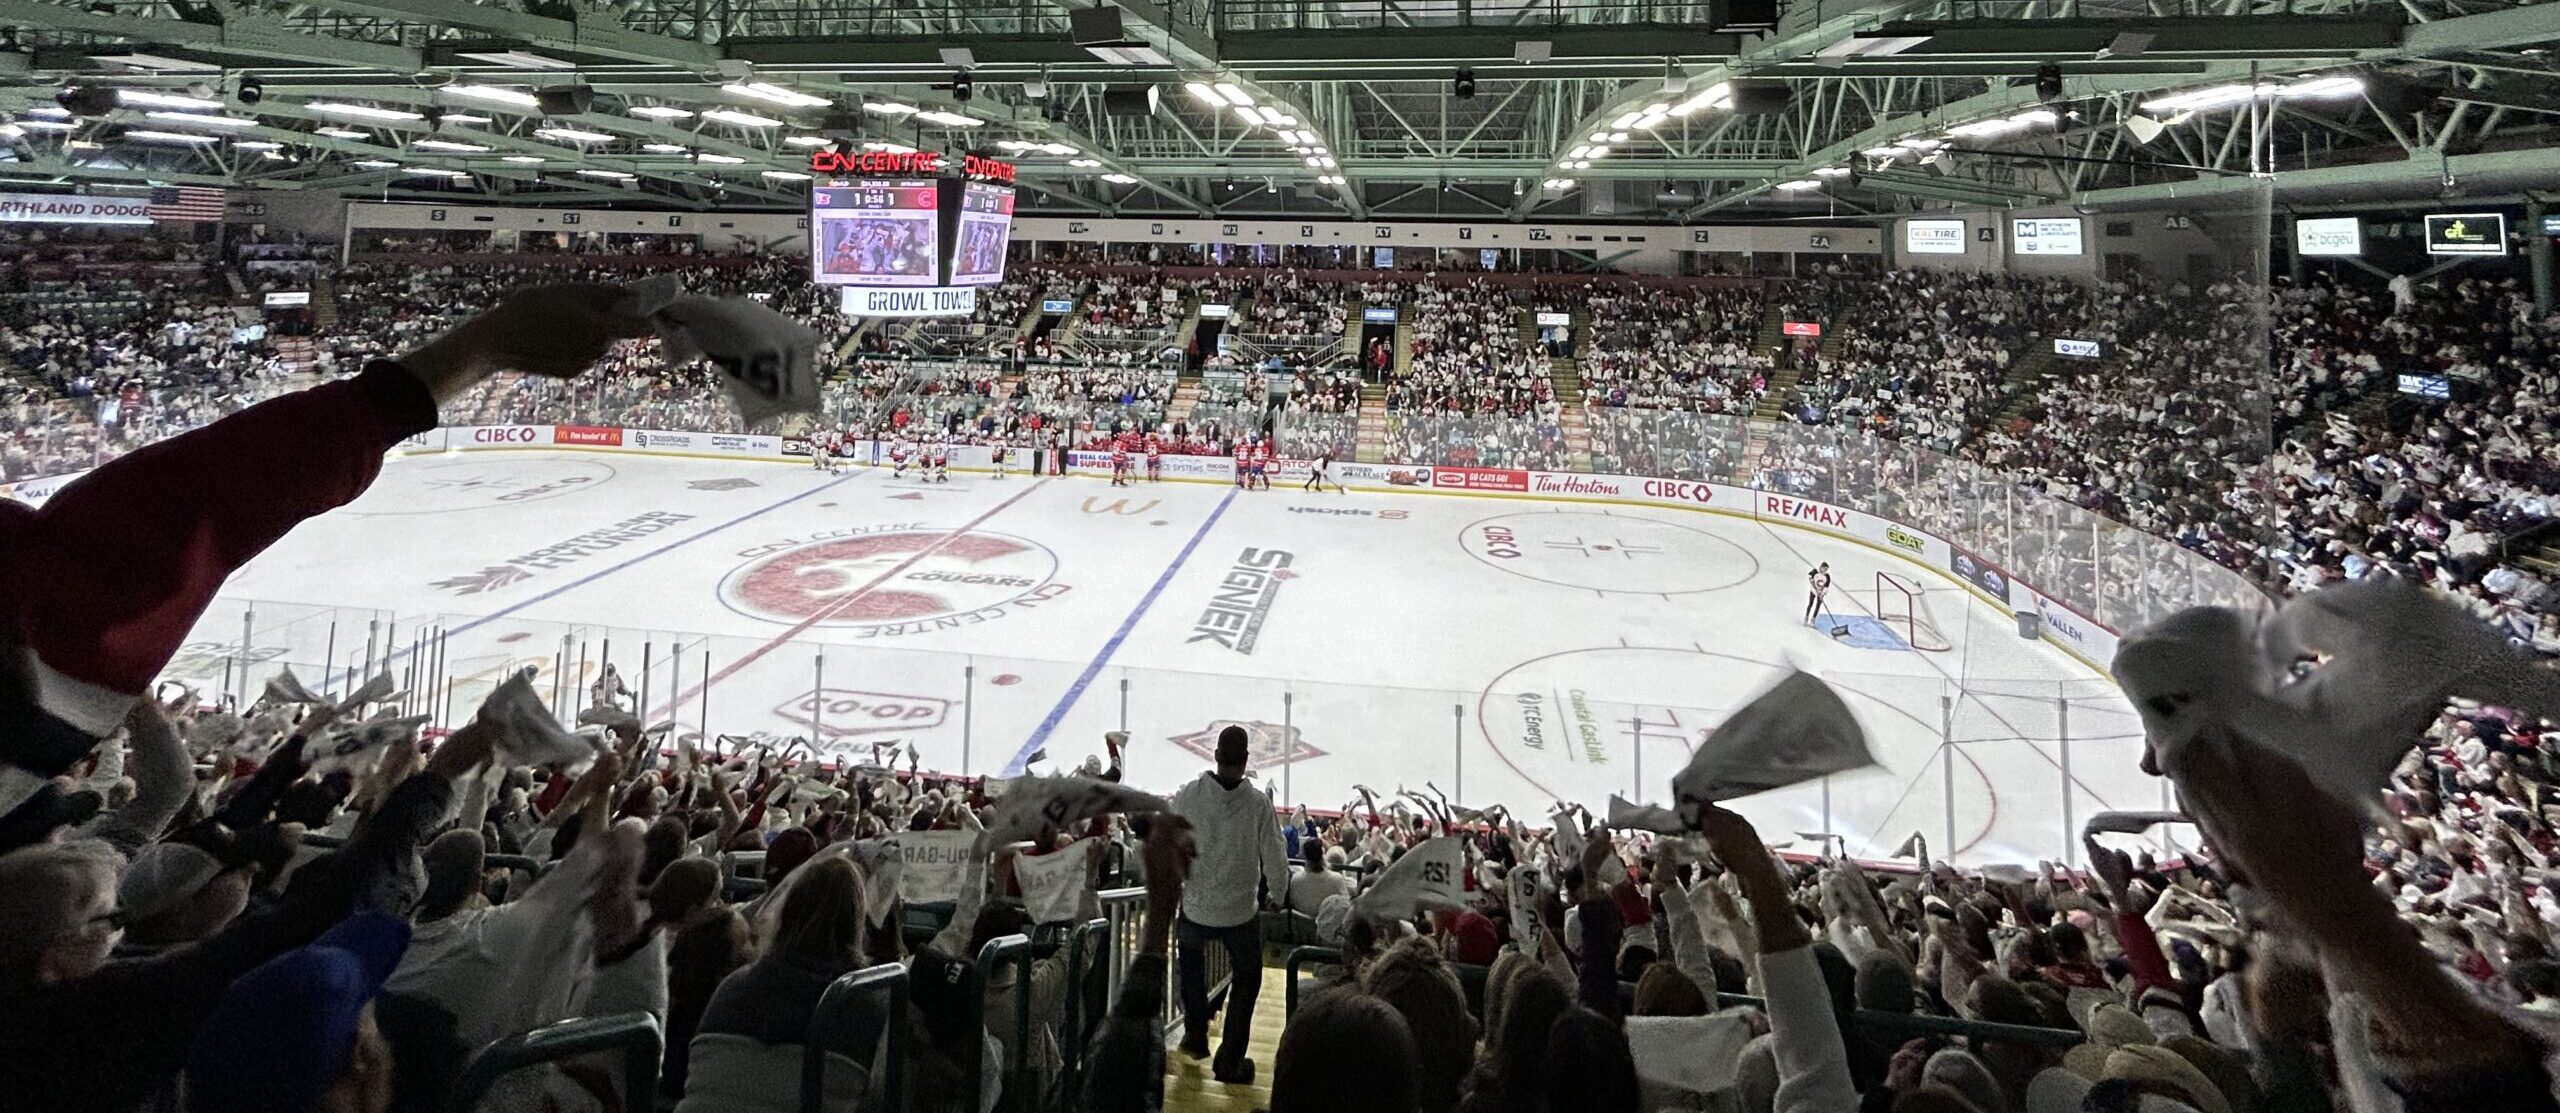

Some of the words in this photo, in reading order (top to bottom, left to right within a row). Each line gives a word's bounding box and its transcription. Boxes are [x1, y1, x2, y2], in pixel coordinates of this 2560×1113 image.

[812, 152, 856, 170] CN
[861, 152, 939, 172] CENTRE
[91, 202, 151, 217] DODGE
[565, 213, 580, 224] ST
[670, 217, 680, 227] T
[2166, 217, 2190, 230] AB
[1152, 224, 1162, 234] W
[1223, 225, 1237, 235] WX
[1303, 226, 1312, 236] X
[1375, 227, 1390, 237] XY
[1460, 229, 1470, 239] Y
[1530, 230, 1545, 240] YZ
[1696, 232, 1706, 242] Z
[1981, 229, 1992, 240] A
[1811, 236, 1829, 248] ZA
[868, 291, 928, 311] GROWL
[474, 428, 517, 443] CIBC
[1469, 472, 1479, 481] GO
[1479, 473, 1495, 482] CATS
[1496, 474, 1508, 483] GO!
[1535, 475, 1560, 493] Tim
[1563, 475, 1620, 496] Hortons
[1644, 480, 1690, 500] CIBC
[1767, 497, 1847, 528] RE/MAX
[507, 510, 668, 566] NORTHLAND
[811, 521, 929, 541] CENTRE
[1483, 526, 1516, 548] CIBC
[1886, 528, 1925, 549] GOAT
[528, 513, 697, 569] HYUNDAI
[904, 571, 1036, 589] COUGARS
[854, 607, 1008, 640] CENTRE
[2047, 615, 2083, 642] VALLEN
[799, 698, 935, 721] CO-OP
[1578, 723, 1608, 766] GasLink
